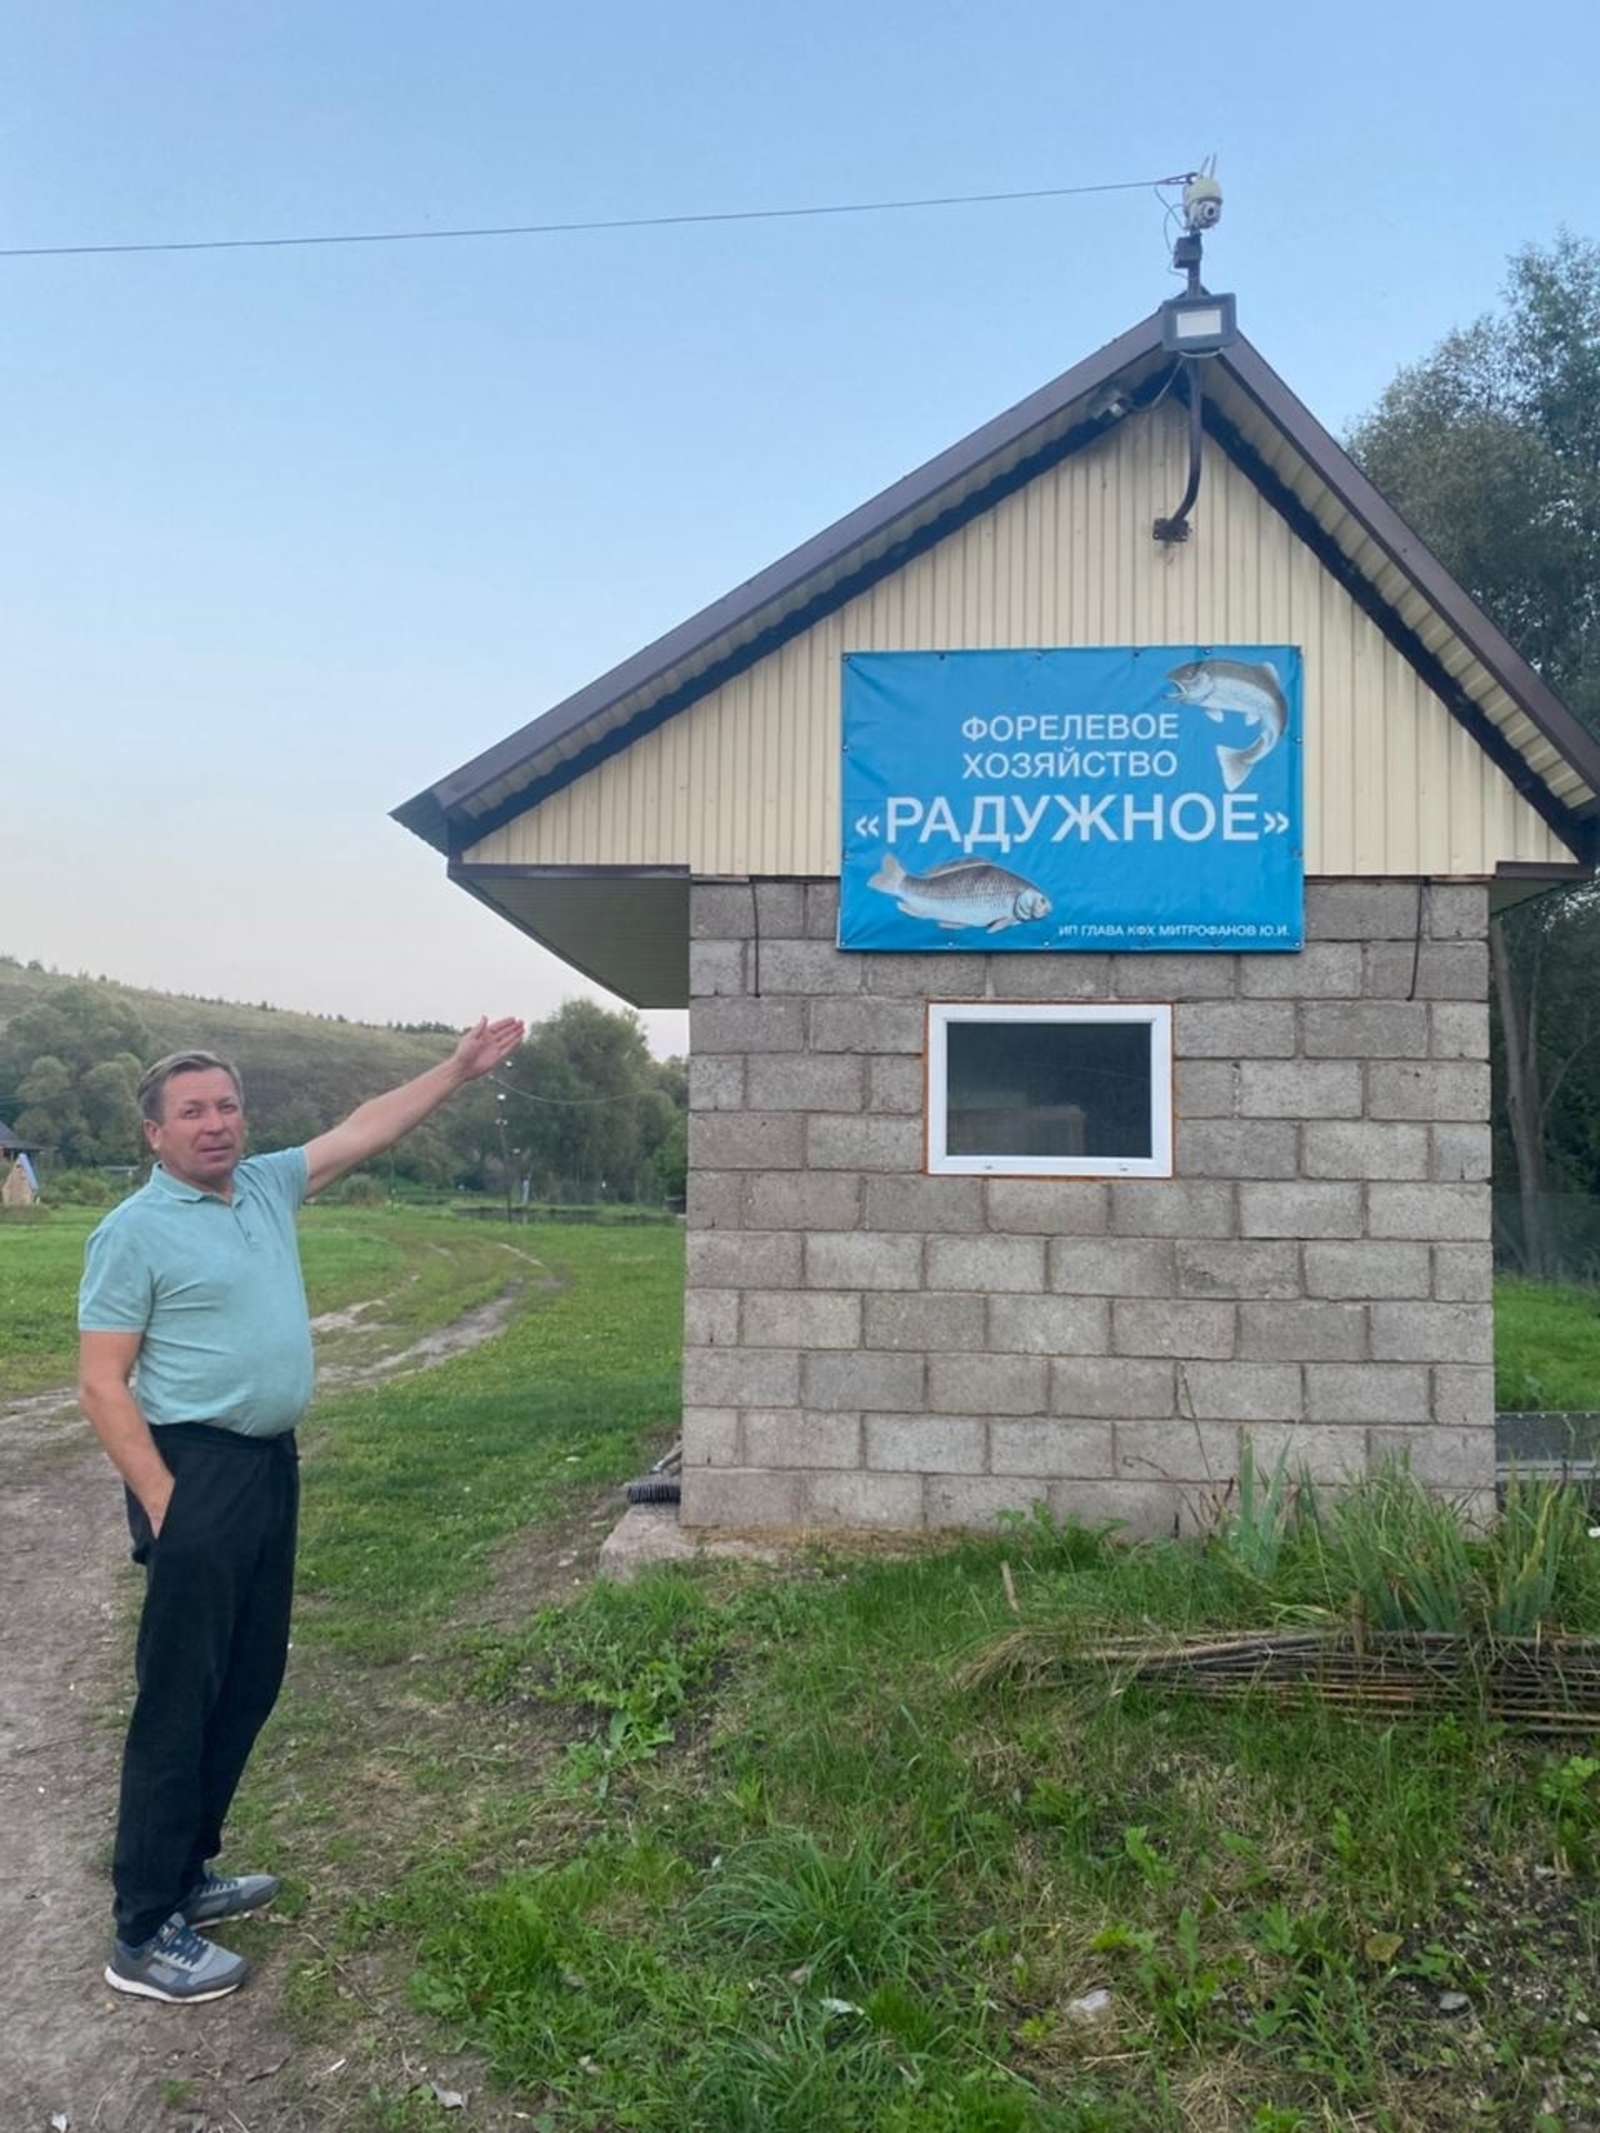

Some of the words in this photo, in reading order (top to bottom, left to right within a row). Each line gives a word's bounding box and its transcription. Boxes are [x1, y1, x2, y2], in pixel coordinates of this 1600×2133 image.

[961, 713, 1179, 741] ФОРЕЛЕВОЕ
[962, 747, 1178, 779] ХОЗЯЙСТВО
[854, 792, 1289, 854] «РАДУЖНОЕ»
[1058, 924, 1078, 936] ИП
[1081, 924, 1124, 936] ГЛАВА
[1127, 924, 1155, 936] КФХ
[1159, 924, 1256, 936] МИТРОФАНОВ
[1259, 924, 1291, 936] Ю.И.
